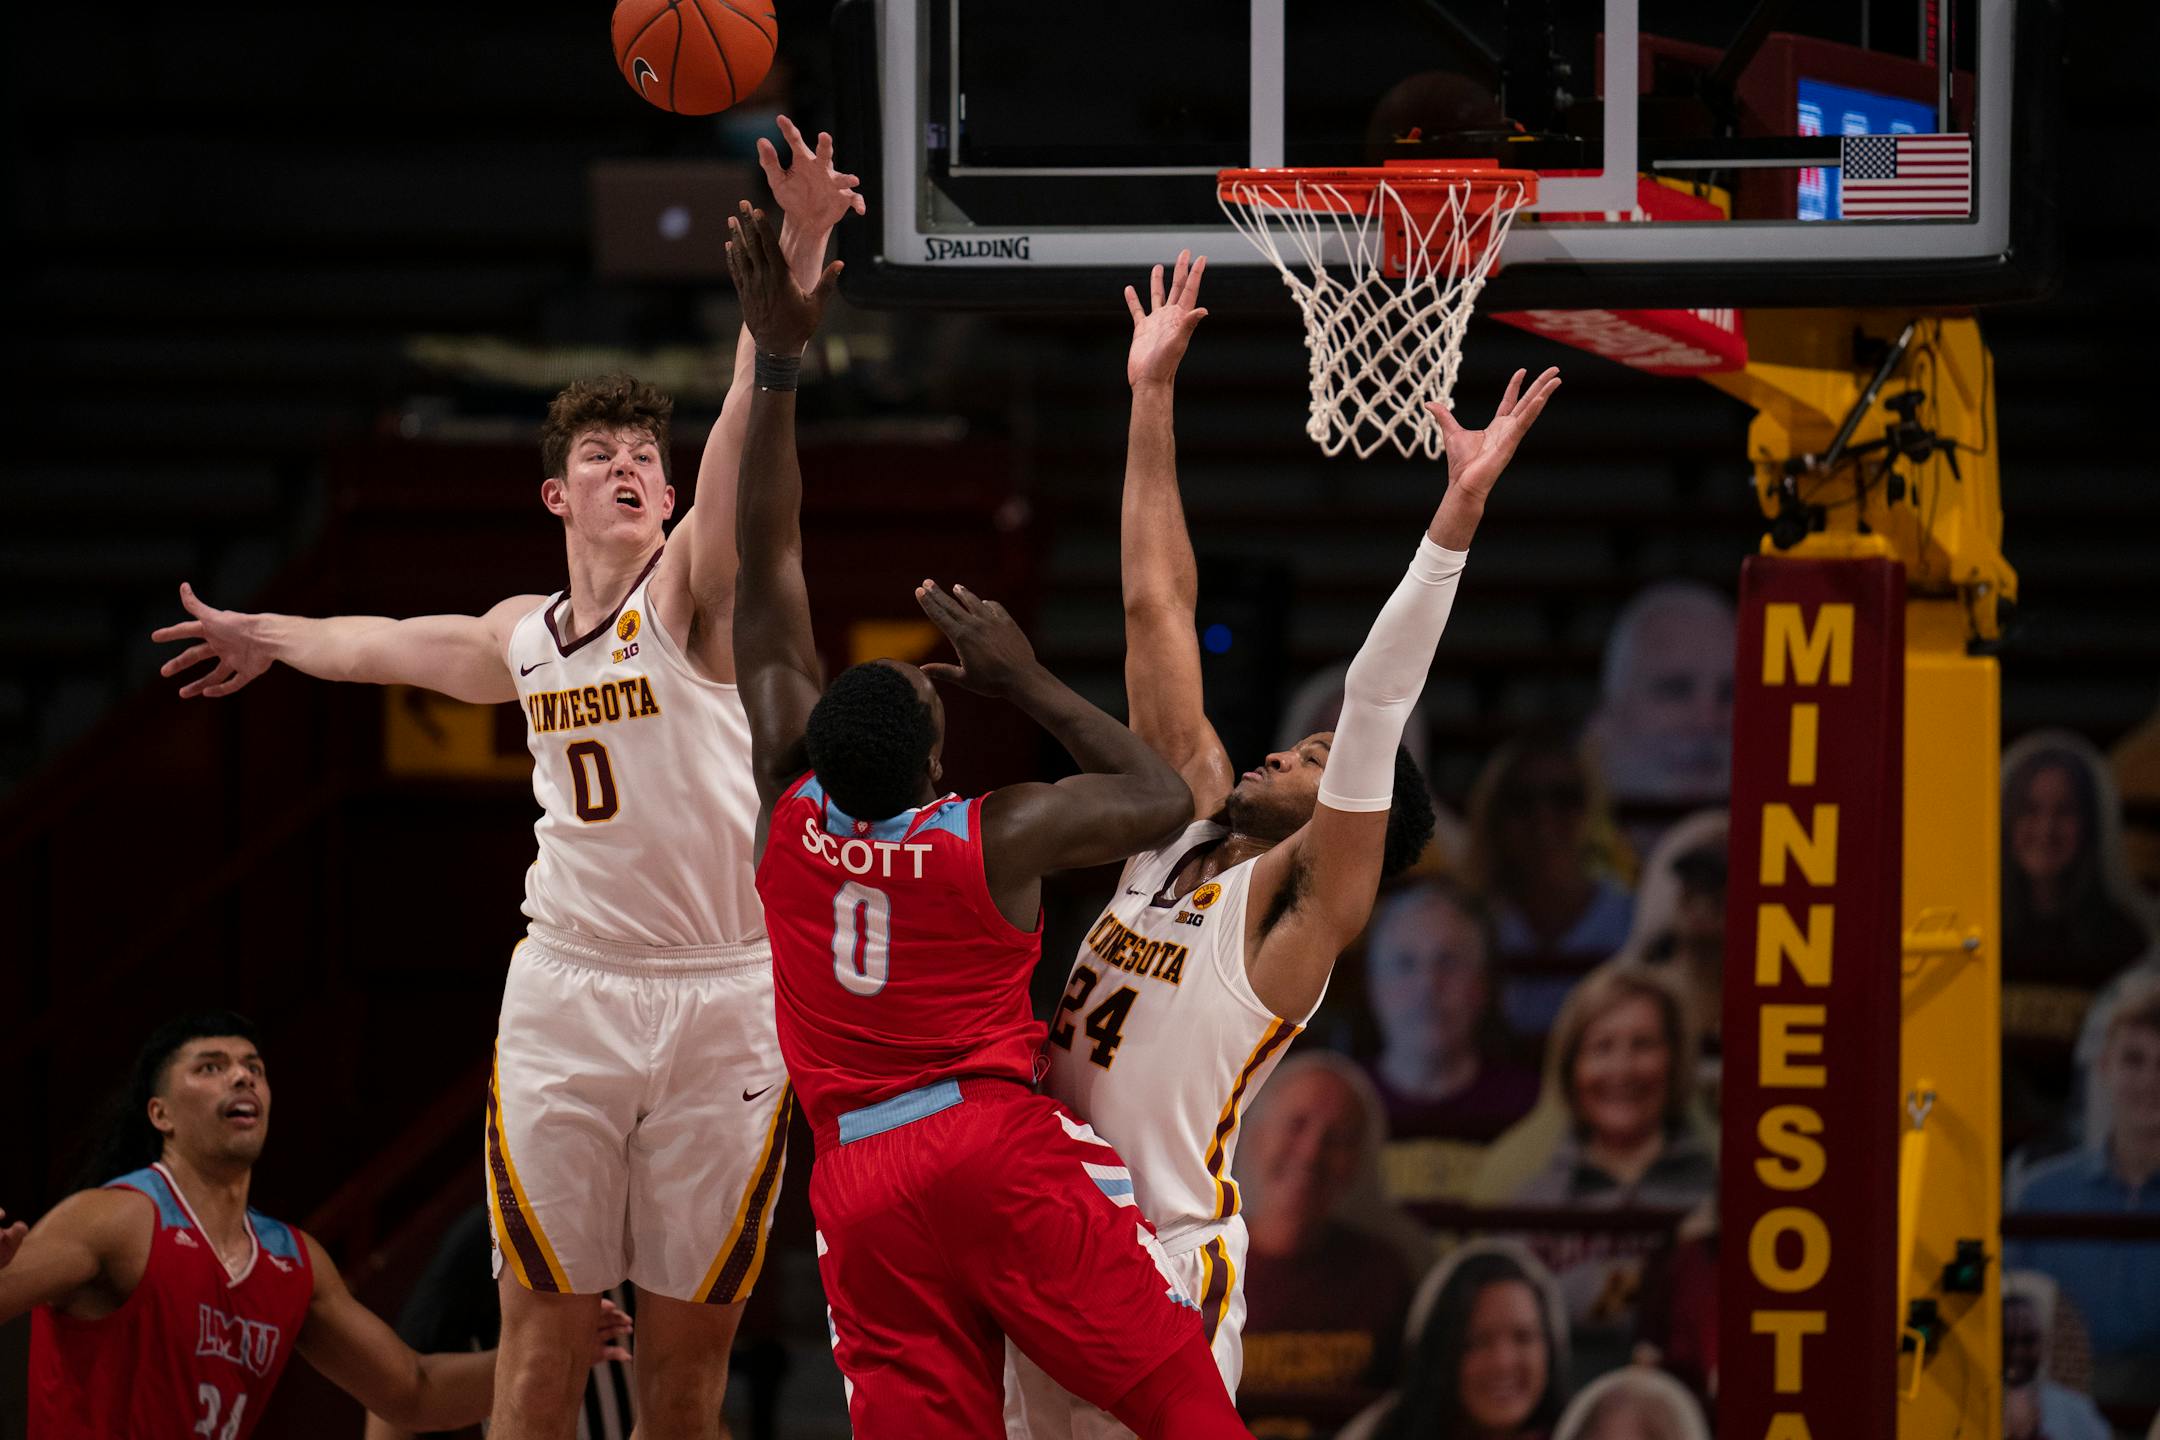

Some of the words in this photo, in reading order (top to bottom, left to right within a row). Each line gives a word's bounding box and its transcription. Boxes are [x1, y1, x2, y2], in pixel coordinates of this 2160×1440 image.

[925, 236, 1030, 262] SPALDING
[527, 675, 661, 734] INNESOTA
[563, 738, 620, 824] 0
[802, 818, 933, 879] SCOTT
[832, 879, 891, 996] 0
[1088, 912, 1189, 985] INNESOTA
[1050, 965, 1138, 1071] 24
[194, 1302, 280, 1378] LMU
